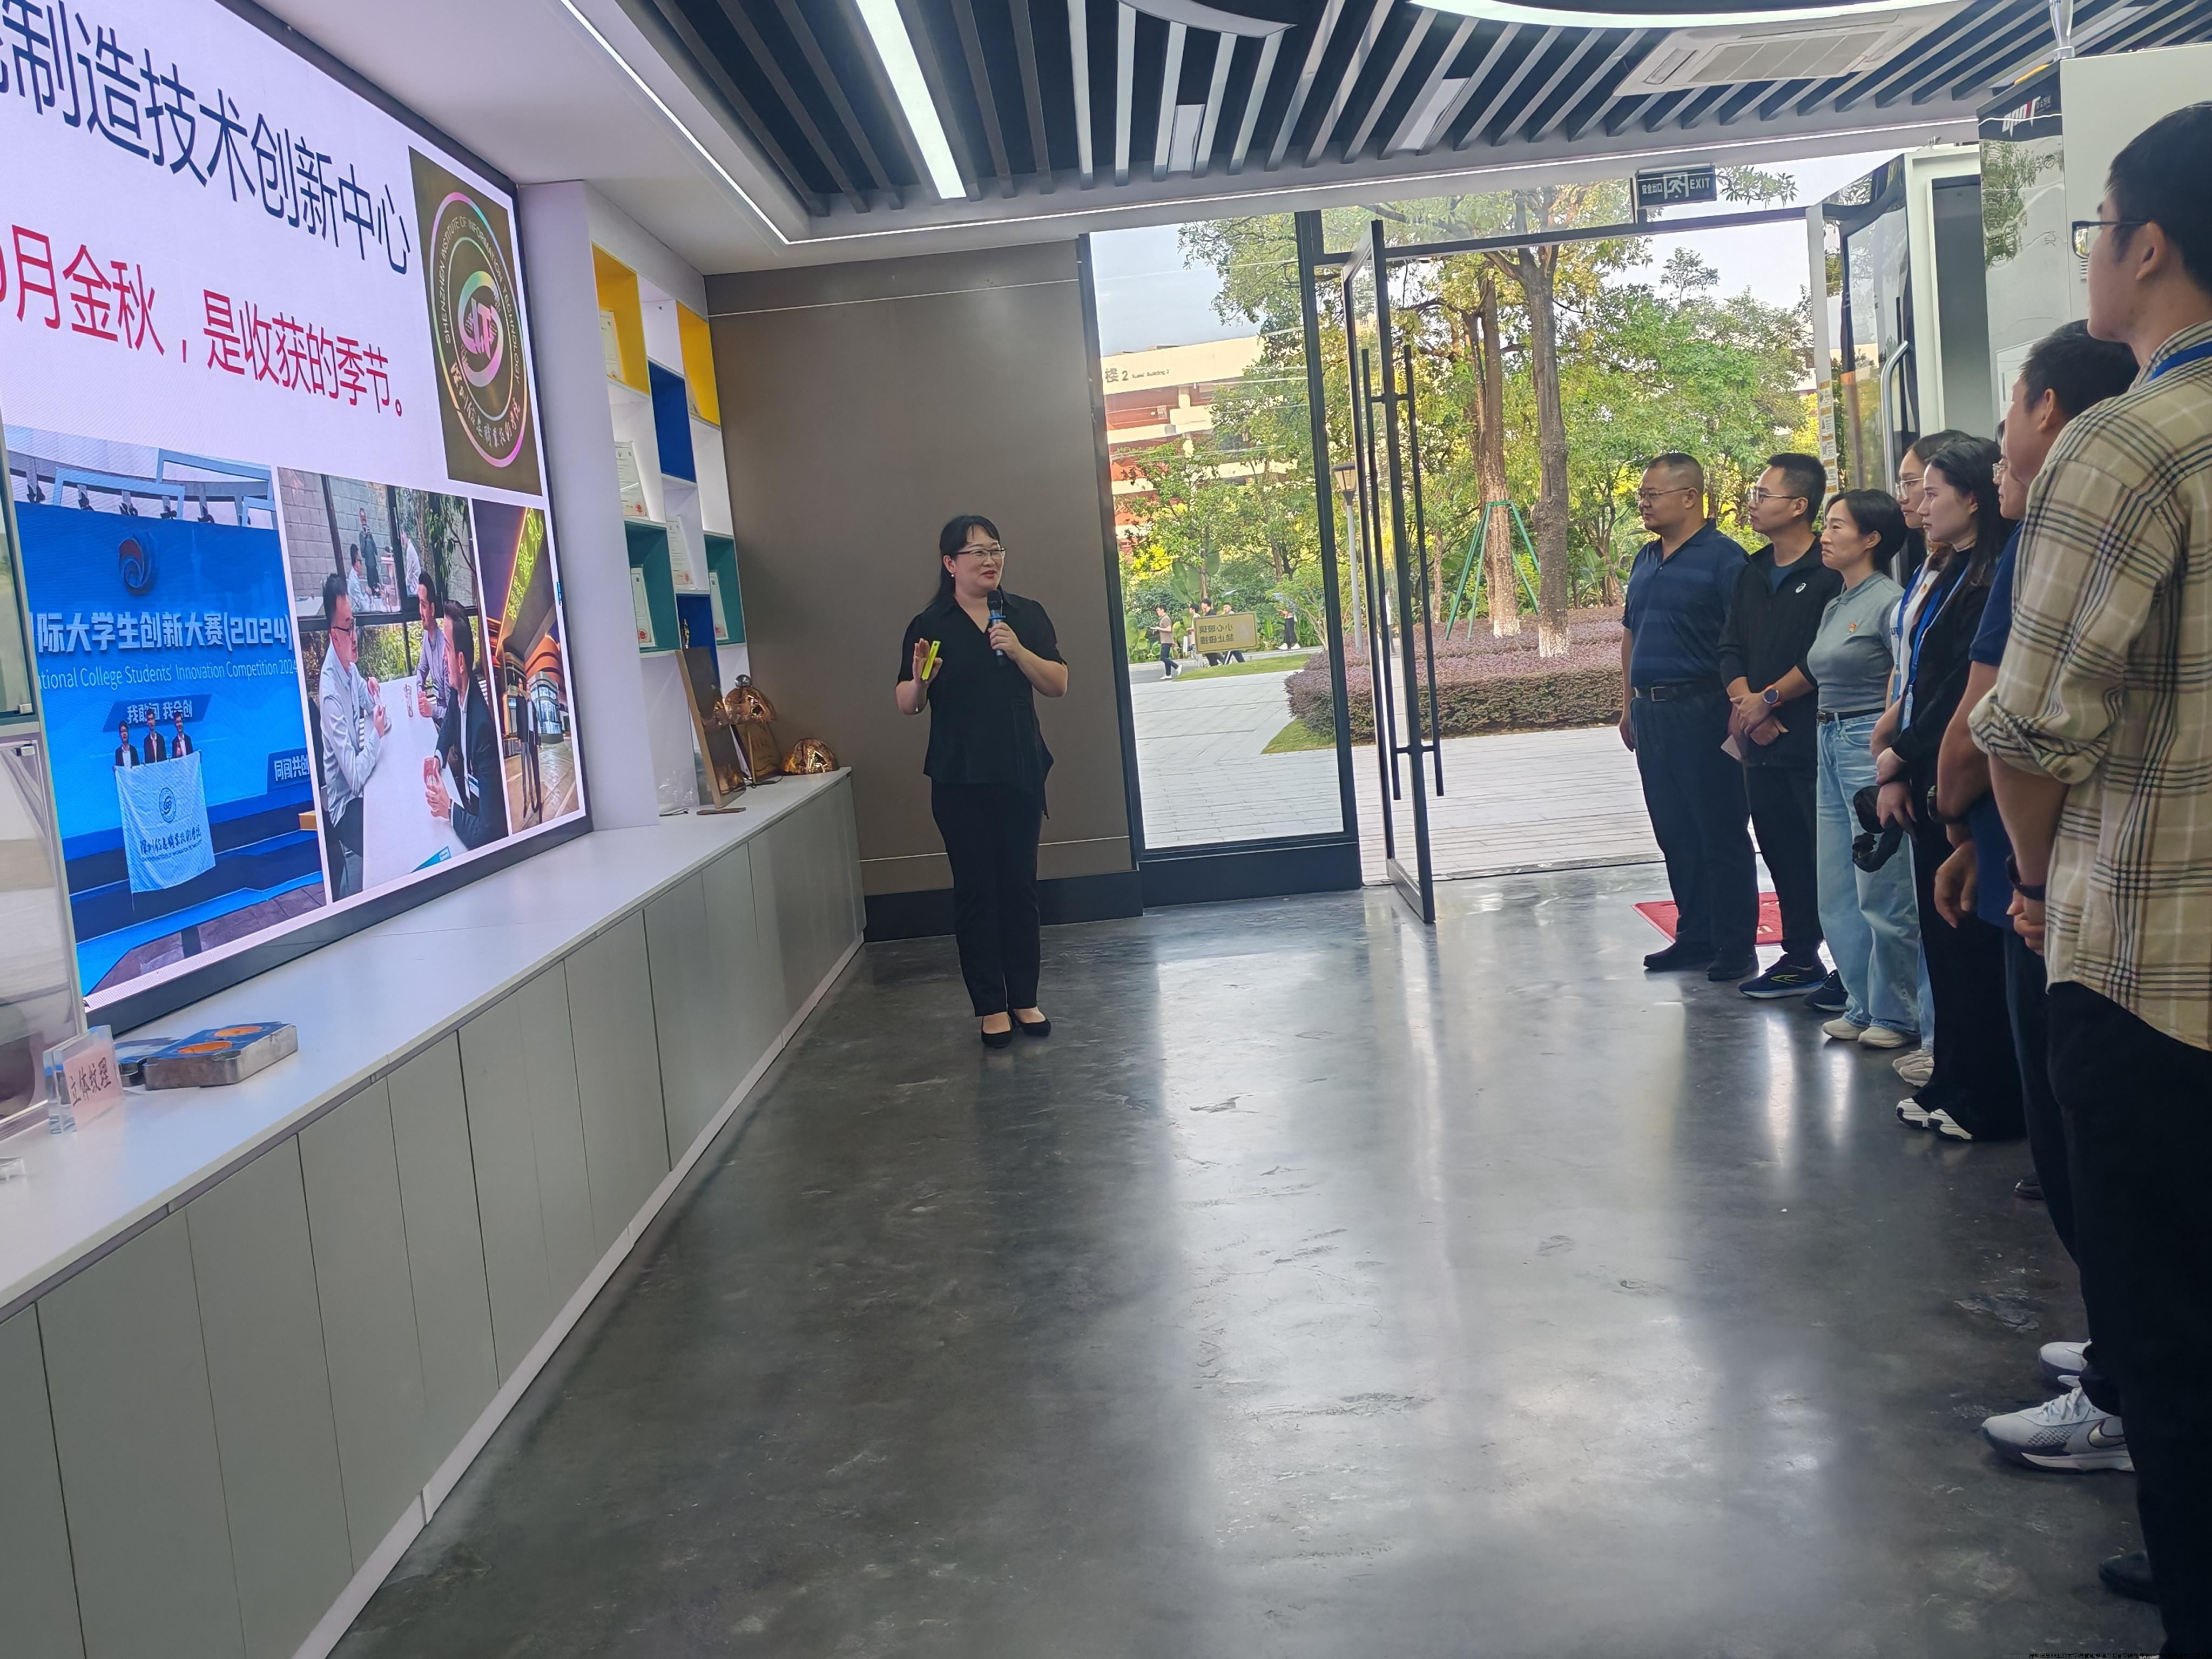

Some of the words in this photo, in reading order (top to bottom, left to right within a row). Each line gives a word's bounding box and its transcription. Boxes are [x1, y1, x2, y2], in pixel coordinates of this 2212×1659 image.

[0, 0, 411, 275] 制造技术创新中心
[1690, 177, 1710, 190] EXIT
[441, 216, 461, 260] INSTITUTE
[468, 219, 503, 283] INFORMATION
[439, 260, 451, 344] SHENZHEN
[503, 285, 521, 386] TECHNOLOGY
[30, 611, 293, 653] 际大学生创新大赛(2024)
[80, 665, 123, 691] College
[176, 662, 225, 680] Innovation
[226, 659, 278, 681] Competition
